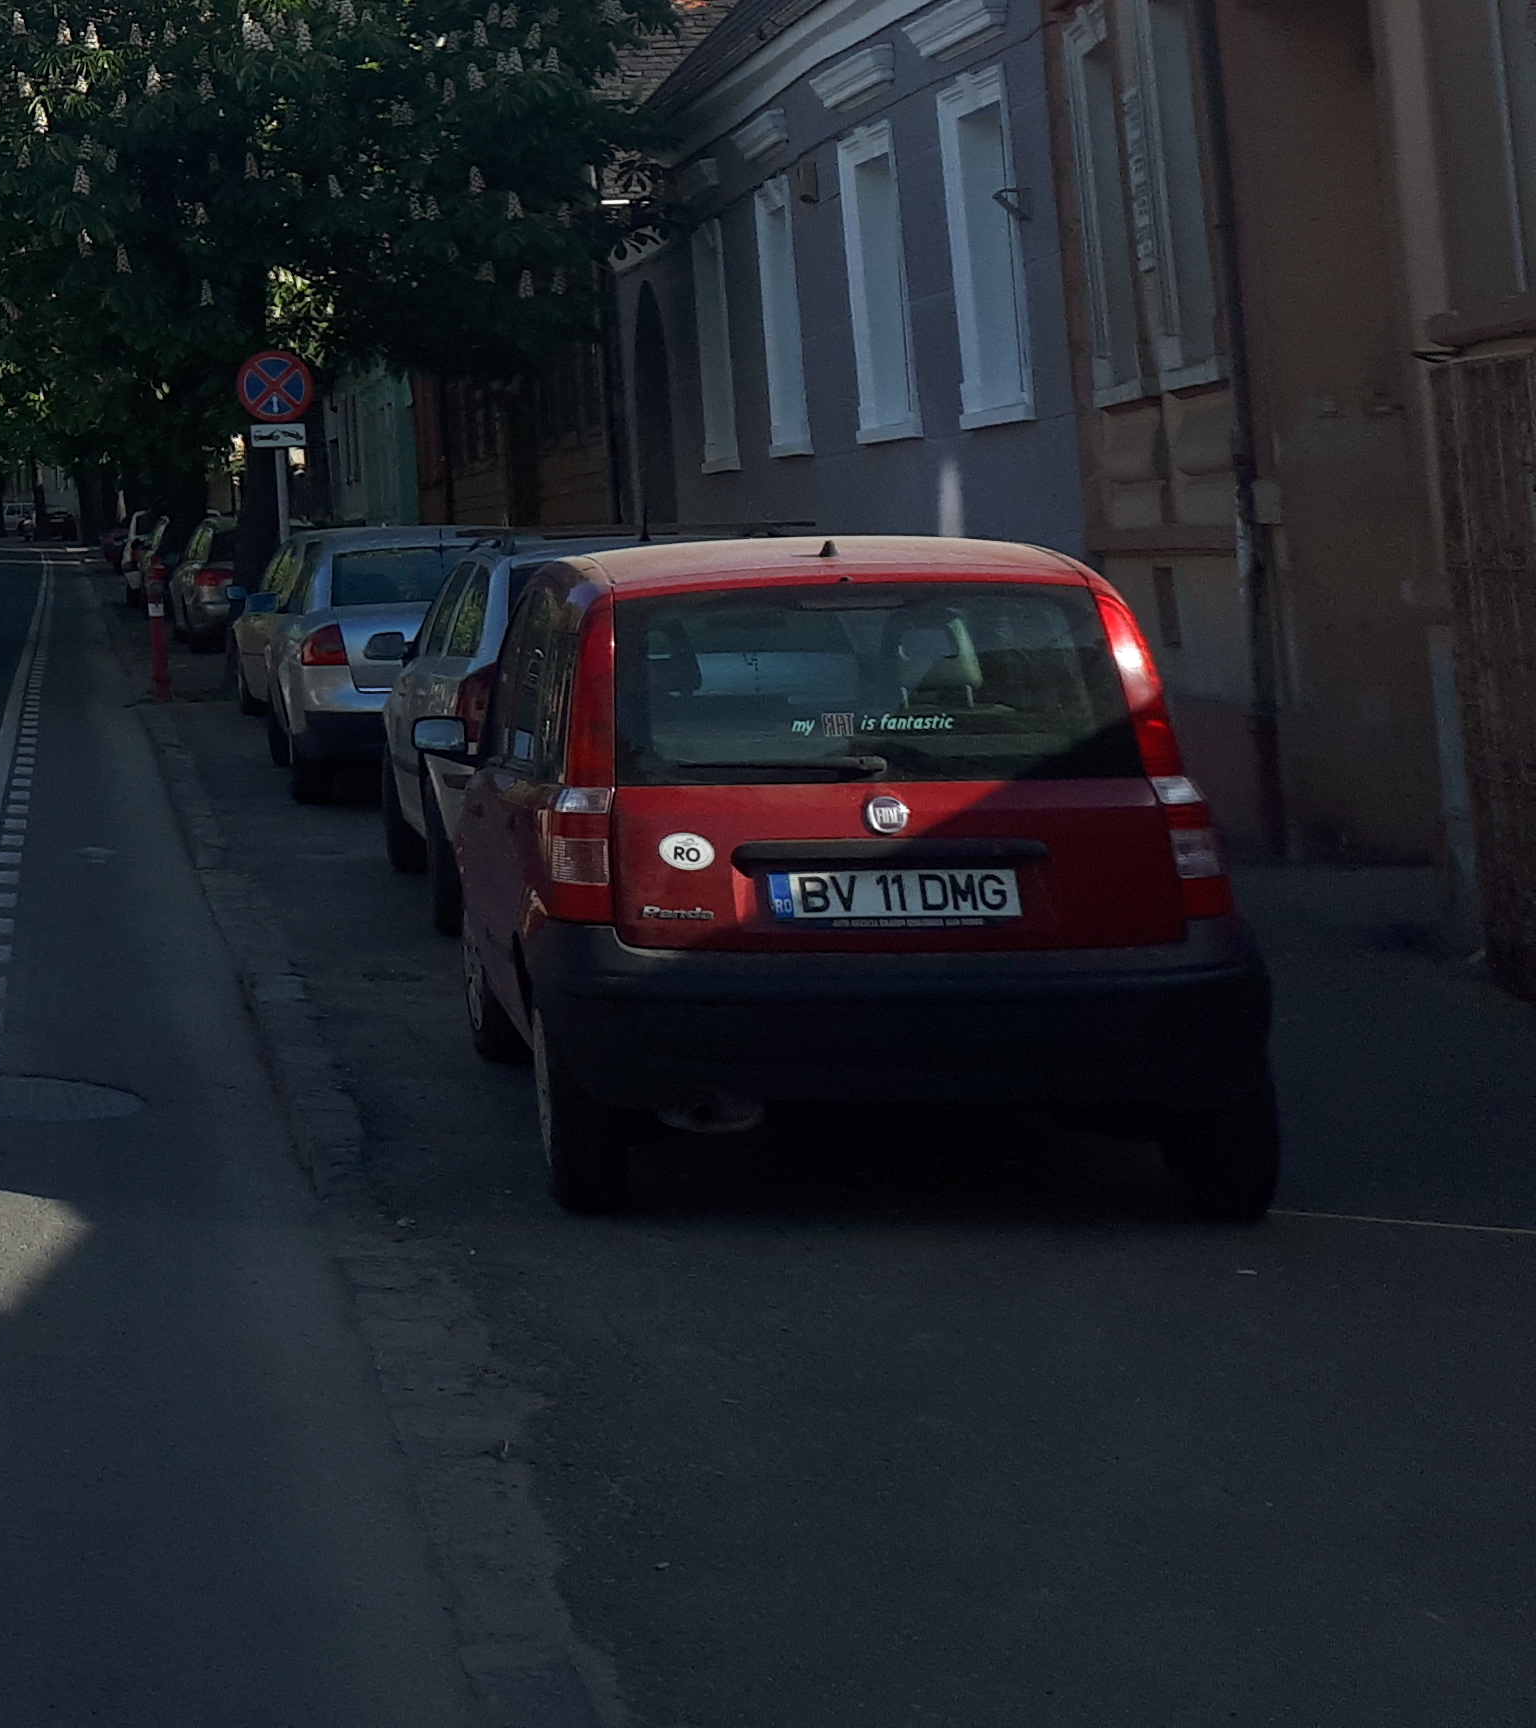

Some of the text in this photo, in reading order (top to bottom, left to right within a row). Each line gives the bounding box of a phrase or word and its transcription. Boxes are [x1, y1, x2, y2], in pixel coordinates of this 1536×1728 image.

[791, 713, 954, 737] my FIAT is fantastic
[673, 846, 701, 862] RO
[774, 873, 1008, 914] RO BV 11 DMG
[642, 905, 715, 920] Panda
